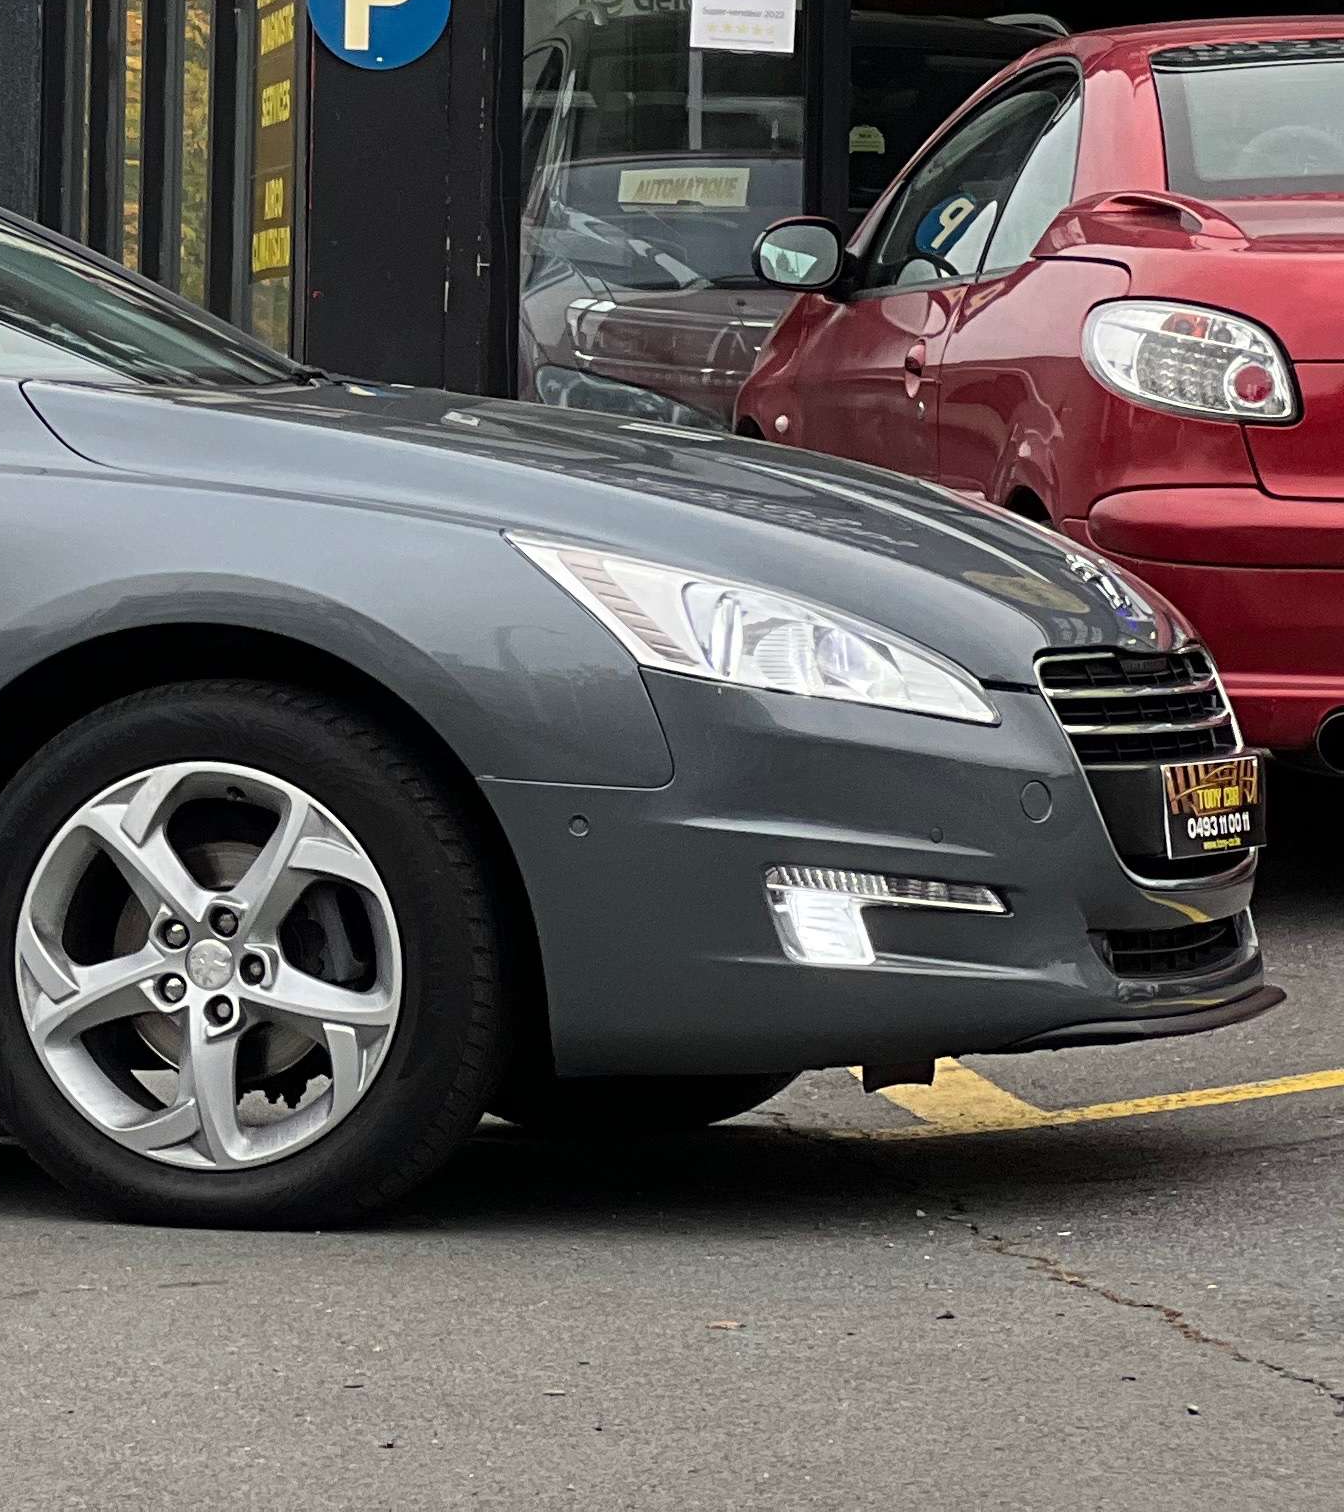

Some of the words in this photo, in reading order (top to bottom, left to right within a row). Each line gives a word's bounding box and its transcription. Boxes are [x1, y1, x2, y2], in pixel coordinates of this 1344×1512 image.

[635, 175, 739, 200] AUTOMATIQUE
[1187, 815, 1219, 839] 0493
[1218, 814, 1228, 835] 11
[1228, 812, 1242, 834] 00
[1242, 810, 1251, 832] 11
